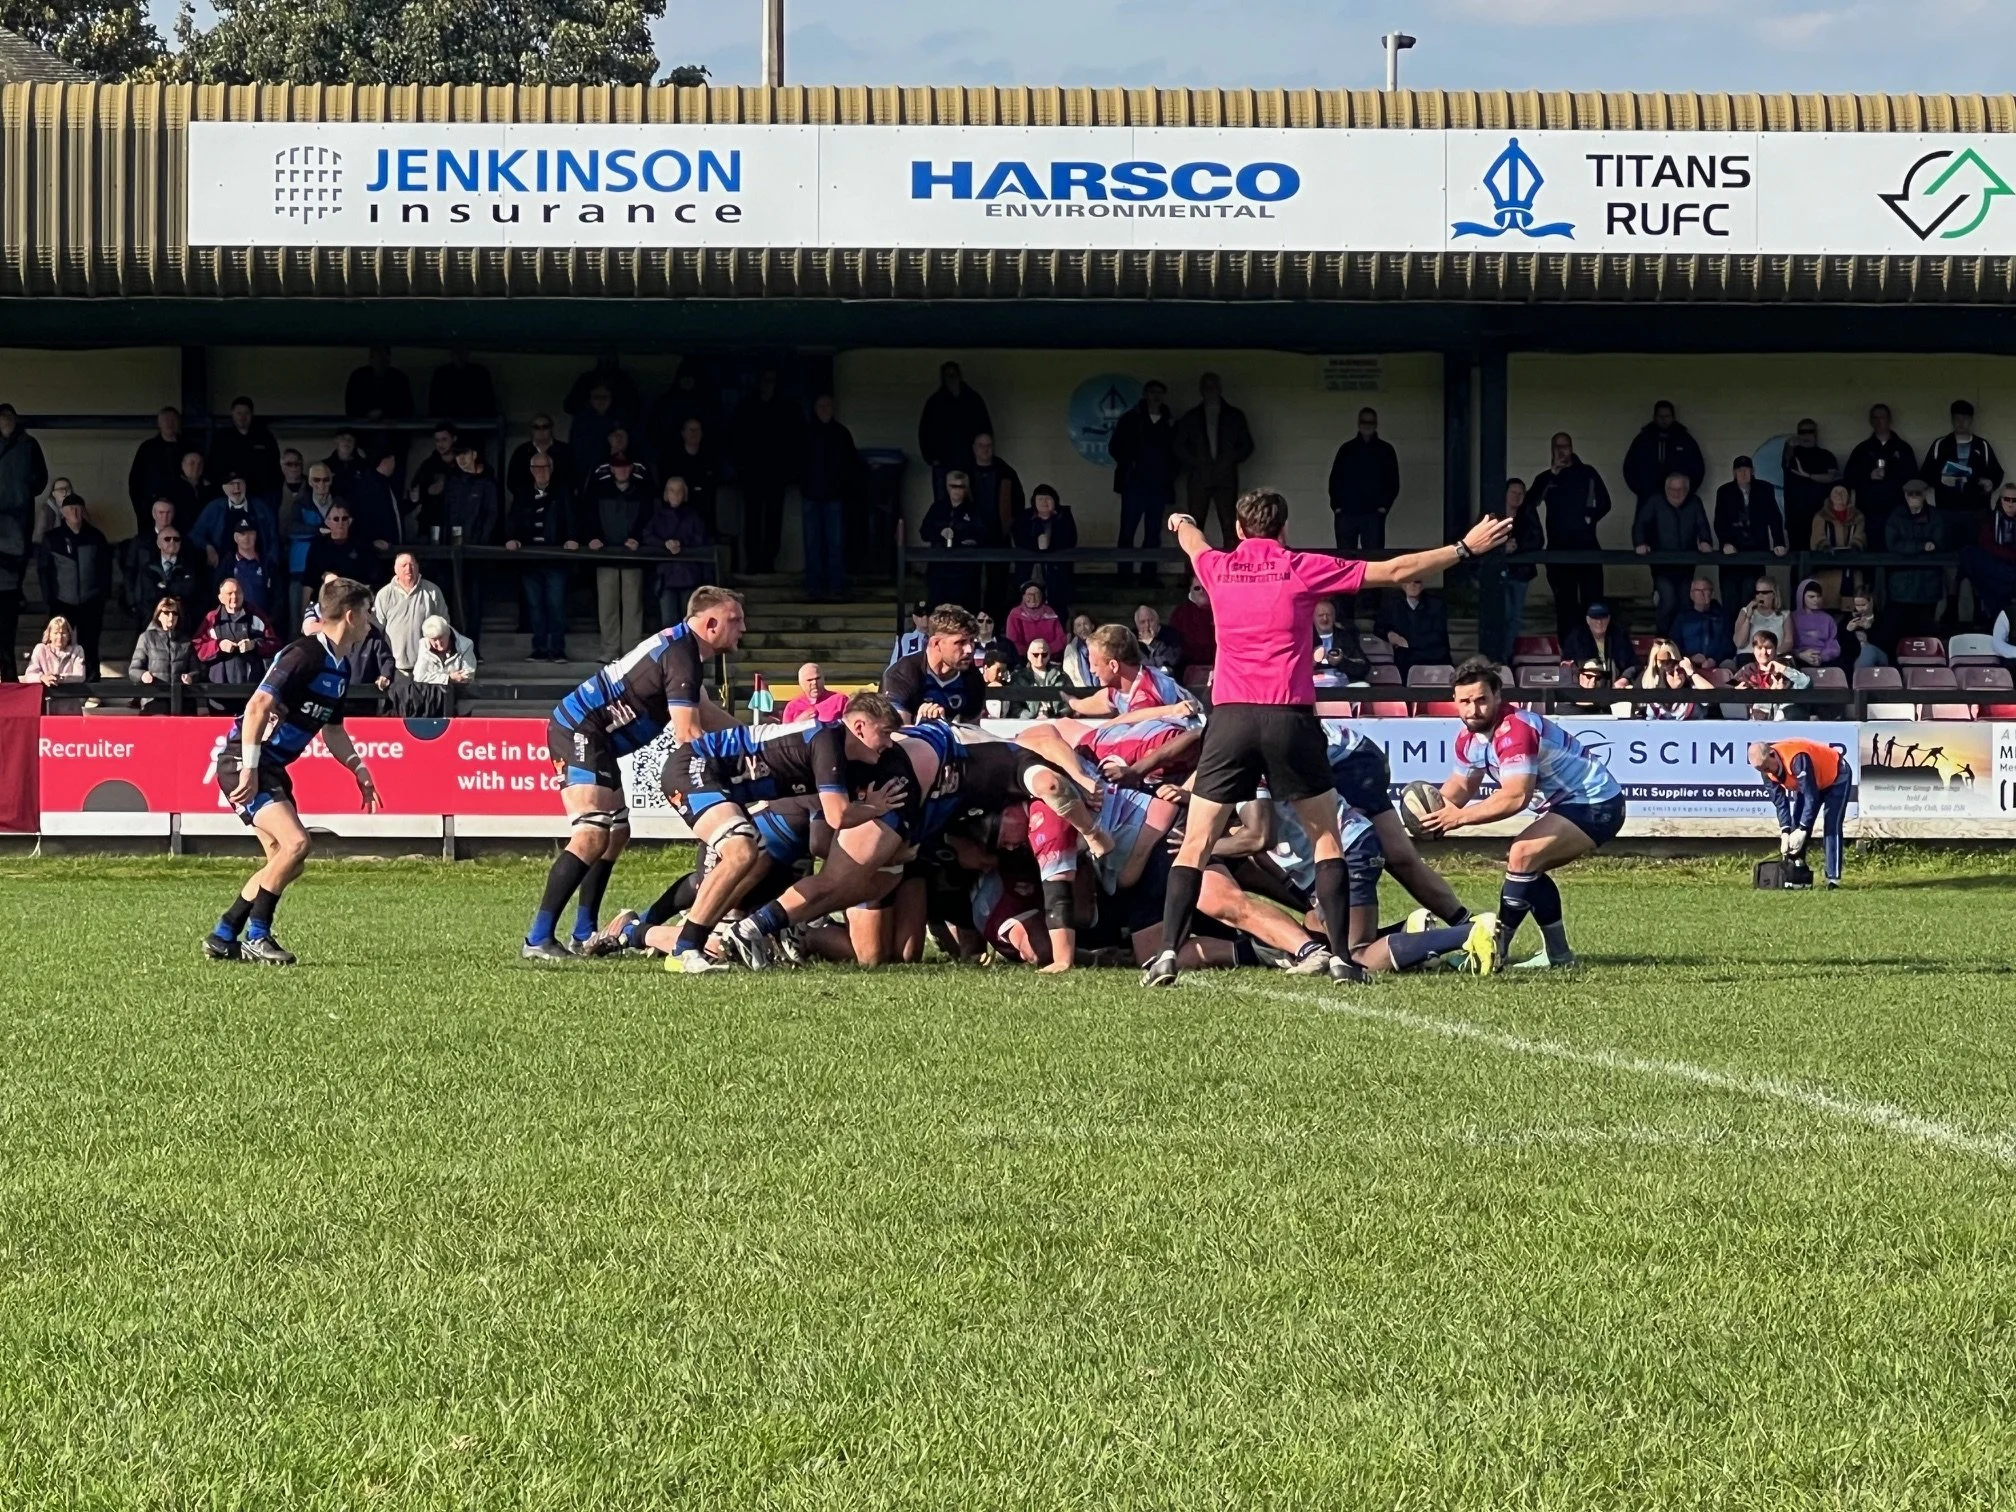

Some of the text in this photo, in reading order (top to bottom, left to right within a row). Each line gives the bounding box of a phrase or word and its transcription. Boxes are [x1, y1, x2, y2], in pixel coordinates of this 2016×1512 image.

[366, 148, 741, 193] JENKINSON
[911, 160, 1300, 202] HARSCO
[1586, 154, 1751, 188] TITANS
[369, 202, 742, 224] insurance
[986, 203, 1275, 218] ENVIRONMENTAL
[1607, 202, 1730, 236] RUFC
[38, 738, 135, 758] Recruiter
[457, 740, 497, 761] Get
[501, 740, 521, 761] in
[527, 742, 551, 761] to
[2000, 745, 2016, 759] M
[457, 770, 505, 790] with
[510, 775, 535, 791] us
[1632, 787, 1648, 798] Kit
[1651, 787, 1699, 799] Supplier
[1702, 787, 1715, 798] to
